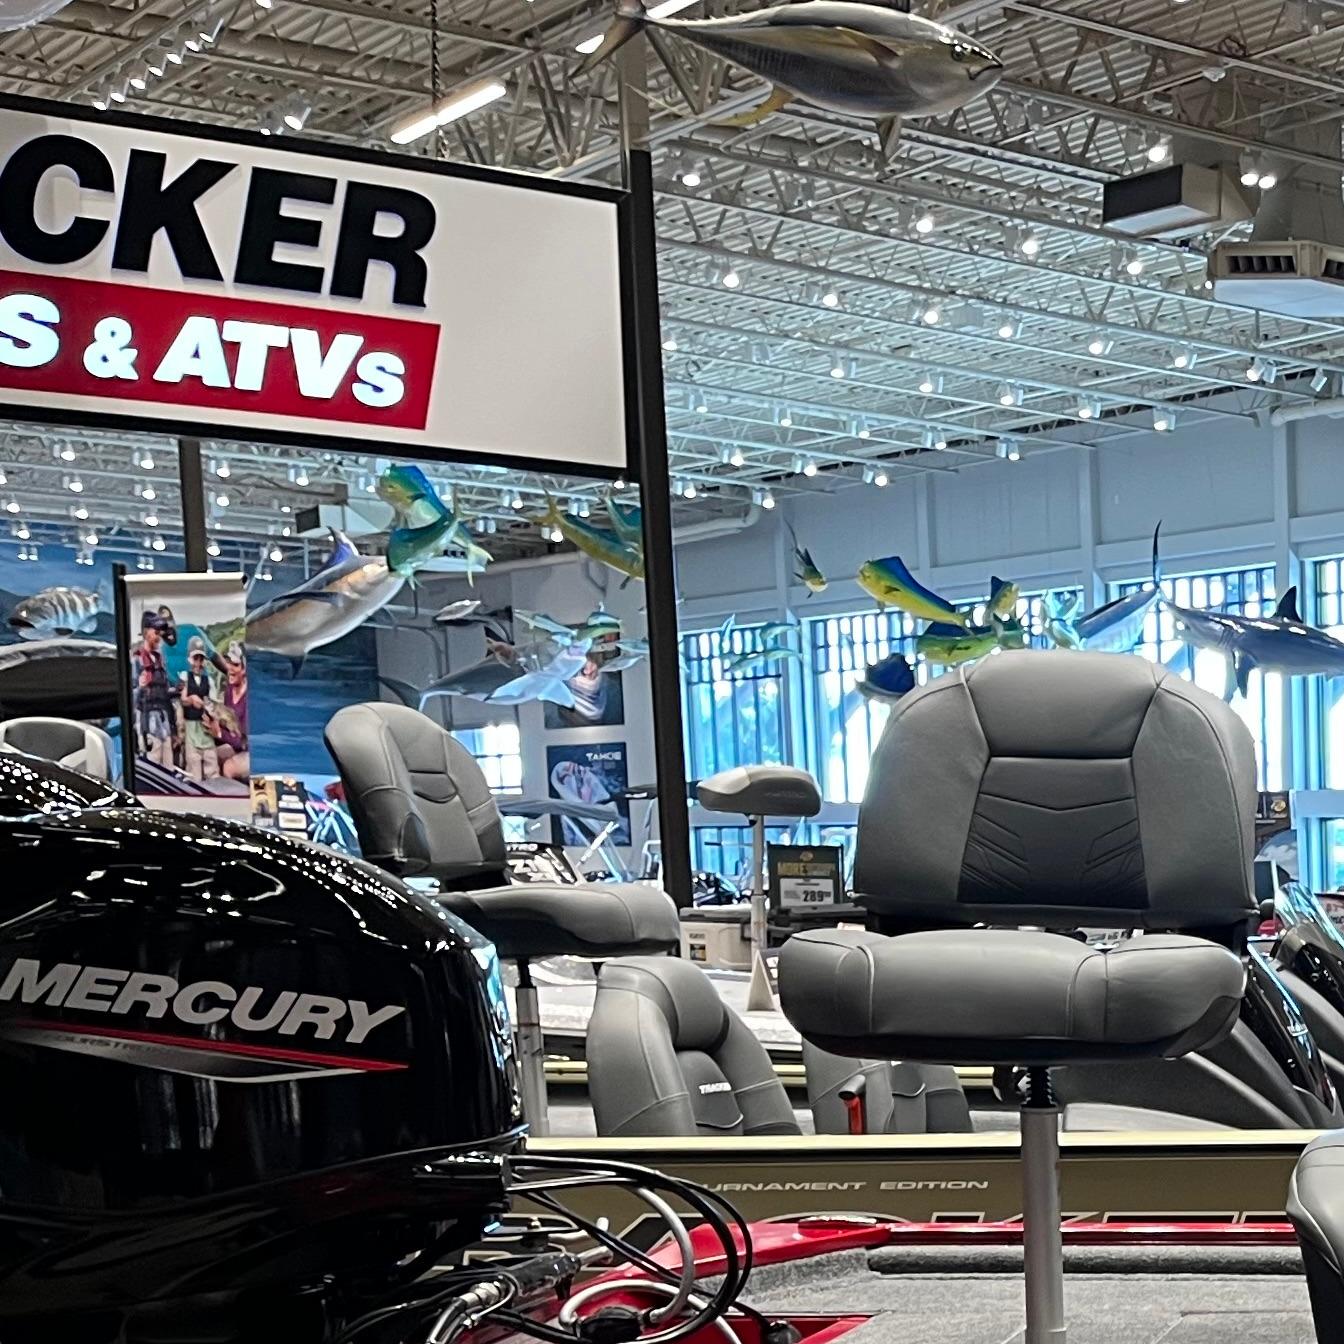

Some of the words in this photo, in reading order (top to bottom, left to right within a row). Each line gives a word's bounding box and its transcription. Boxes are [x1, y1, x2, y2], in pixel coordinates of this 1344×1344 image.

[83, 316, 139, 381] &
[153, 316, 406, 408] ATVs
[0, 958, 406, 1044] MERCURY
[703, 1181, 867, 1192] URNAMENT
[879, 1180, 989, 1191] EDITION
